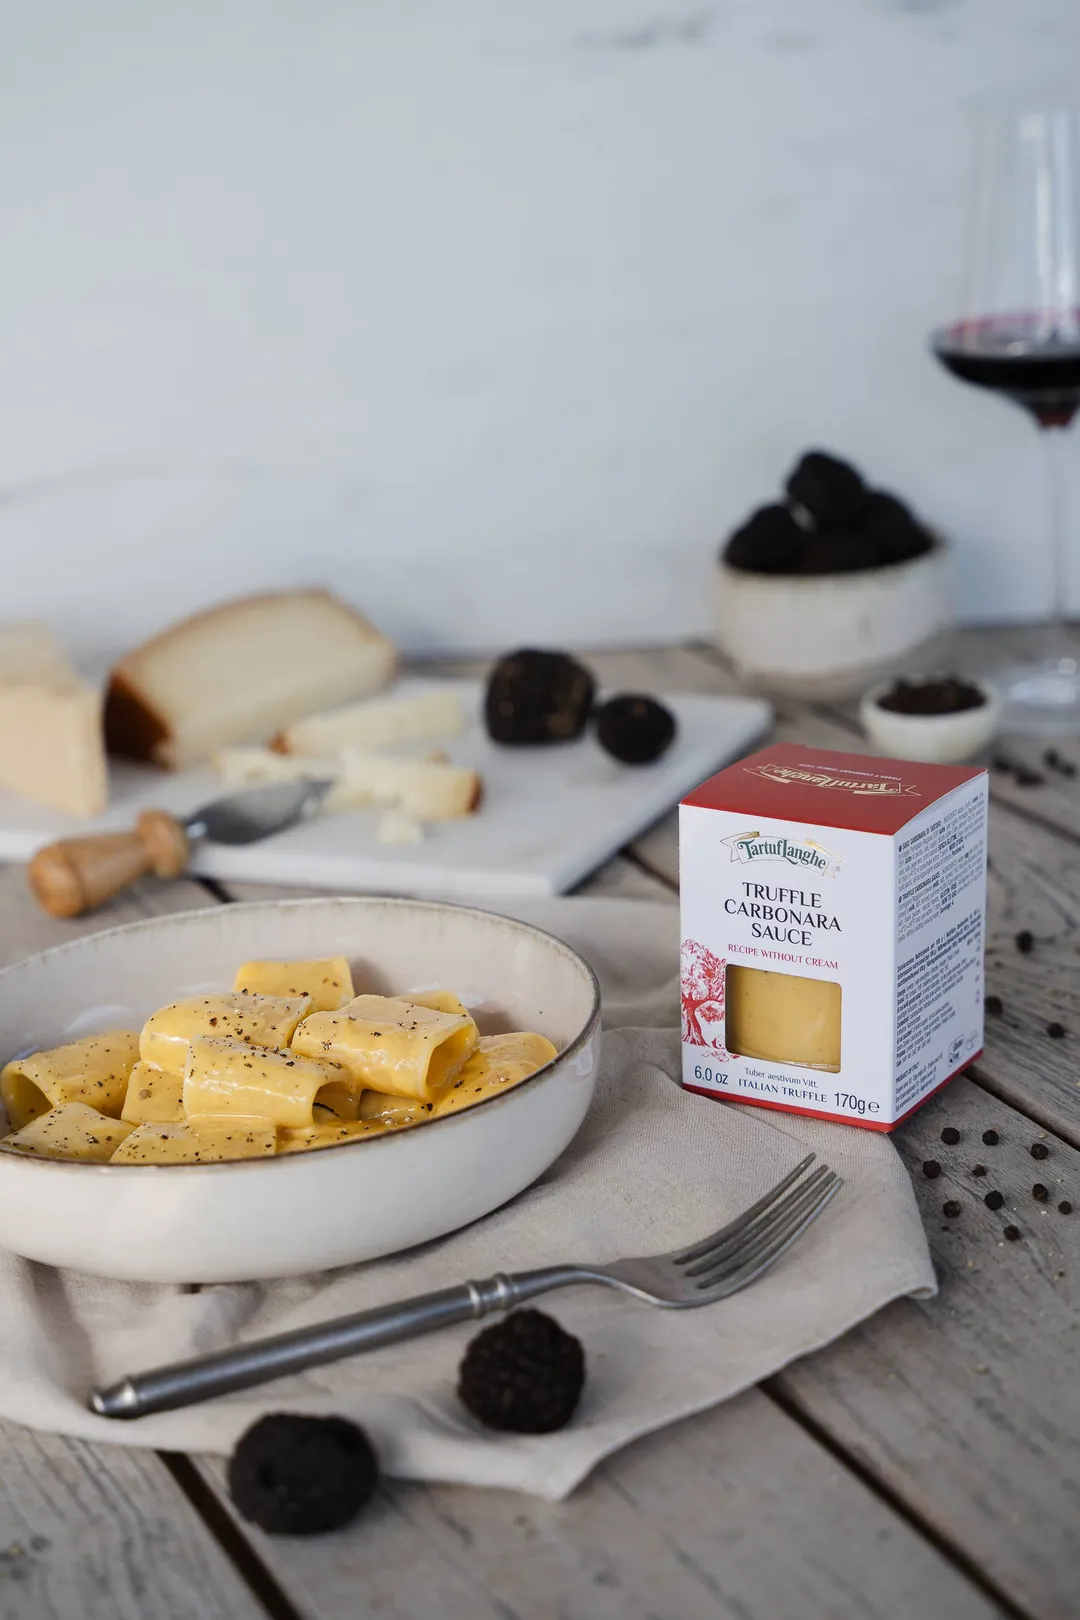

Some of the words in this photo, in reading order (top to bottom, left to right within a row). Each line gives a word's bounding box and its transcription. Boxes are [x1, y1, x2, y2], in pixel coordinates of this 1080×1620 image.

[742, 881, 822, 909] TRUFFLE
[724, 898, 842, 932] CARBONARA
[751, 922, 812, 946] SAUCE
[728, 943, 759, 957] RECIPE
[760, 949, 803, 964] WITHOUT
[805, 957, 839, 970] CREAM
[694, 1065, 713, 1082] 6.0
[715, 1073, 729, 1085] oz
[745, 1067, 766, 1079] Tuber
[767, 1072, 801, 1085] aestivum
[802, 1077, 819, 1089] Vitt.
[738, 1078, 779, 1094] ITALIAN
[781, 1086, 827, 1103] TRUFFLE
